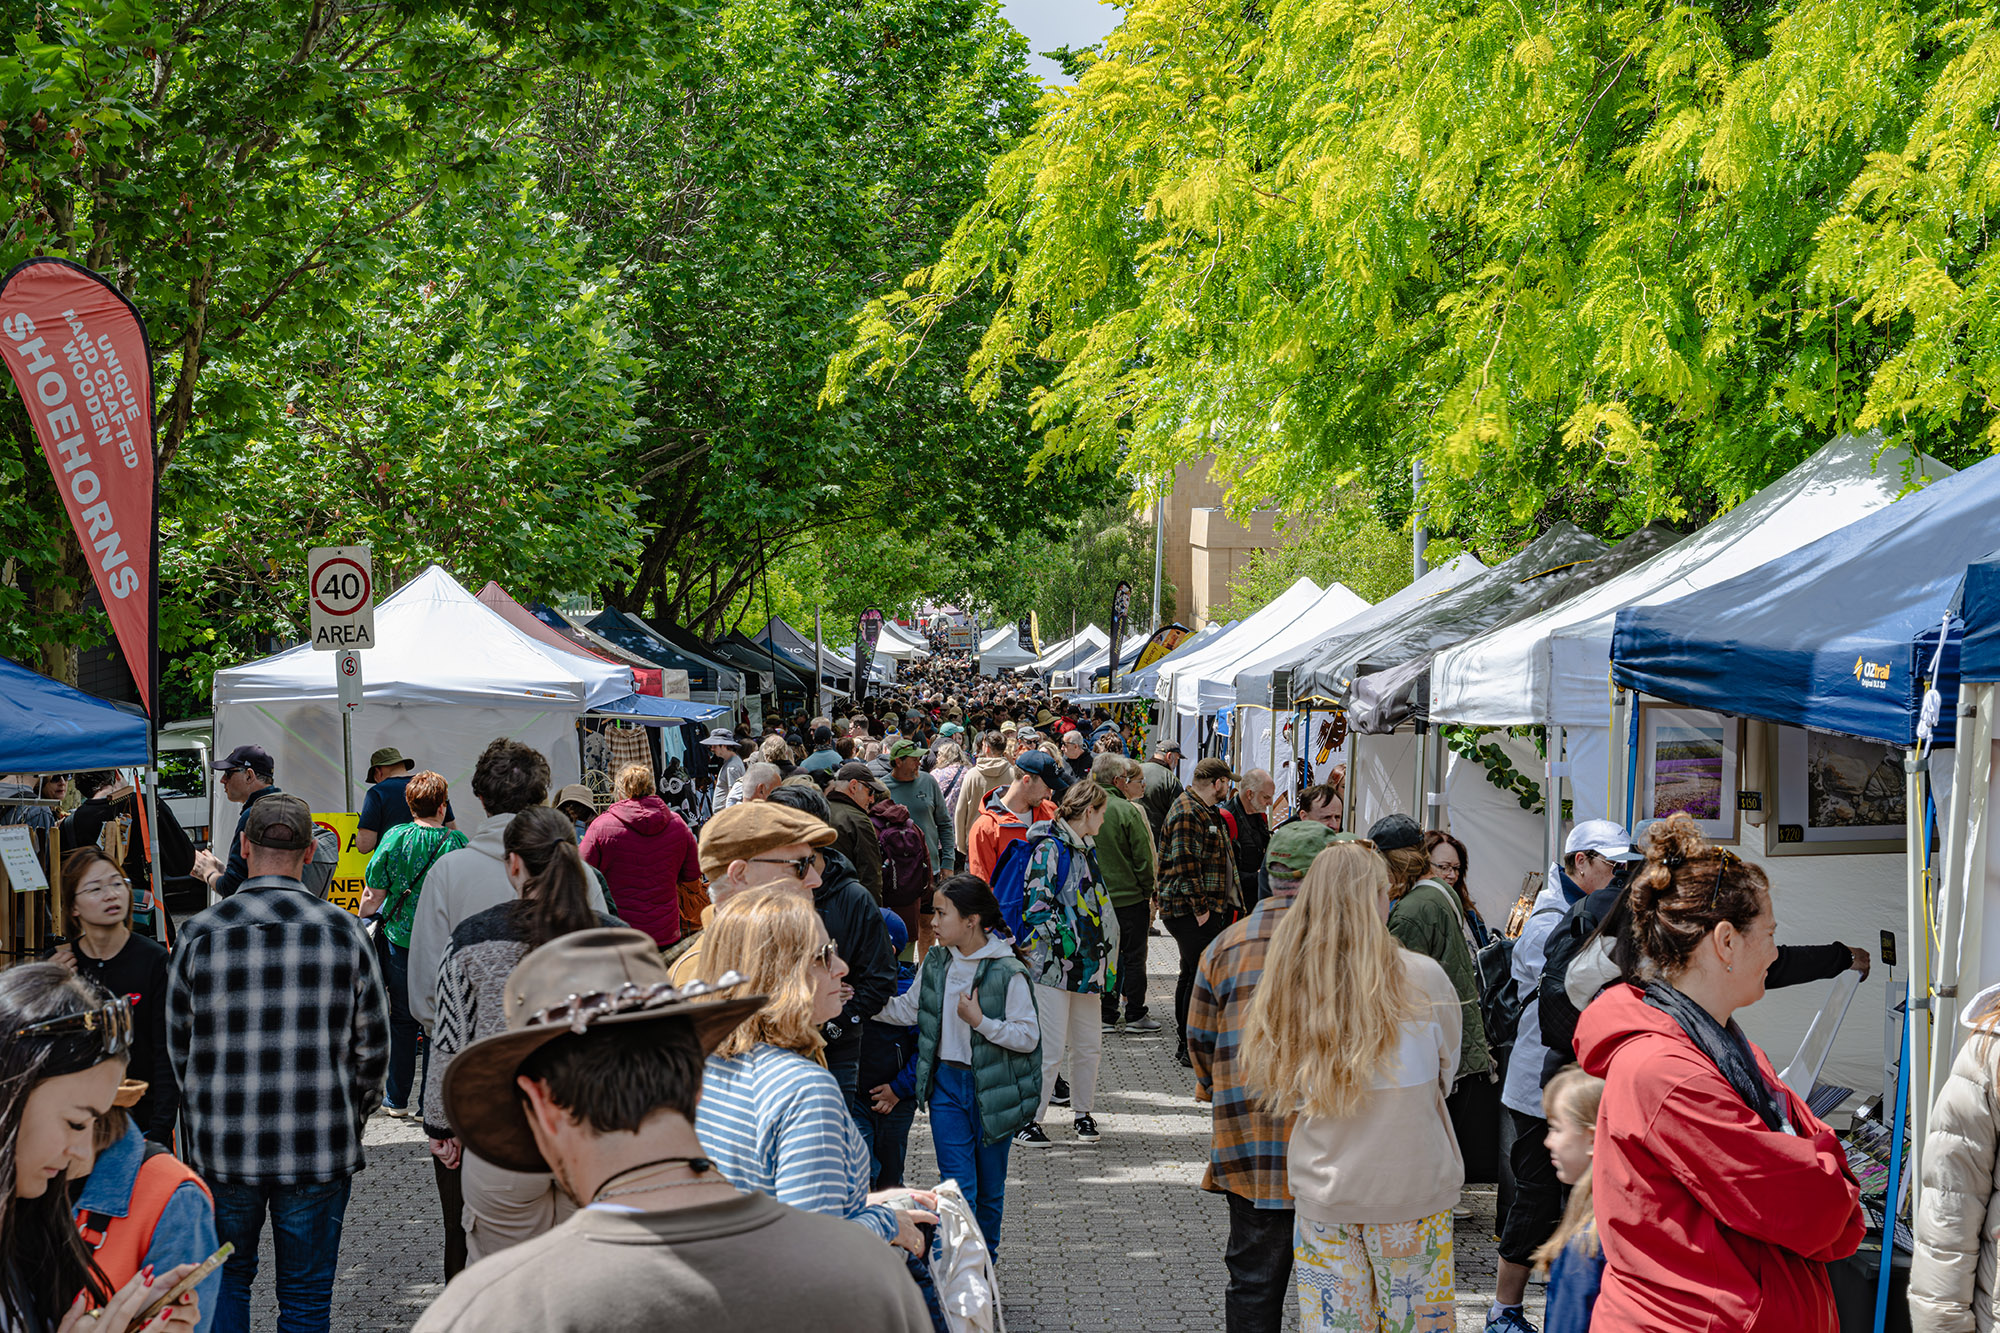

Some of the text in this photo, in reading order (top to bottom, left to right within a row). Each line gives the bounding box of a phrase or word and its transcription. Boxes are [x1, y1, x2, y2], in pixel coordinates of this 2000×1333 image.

[61, 308, 139, 470] HAND CRAFTED
[62, 340, 113, 447] WOODEN
[97, 333, 140, 421] UNIQUE
[2, 311, 140, 600] SHOEHORNS
[321, 573, 360, 600] 40
[316, 624, 370, 646] AREA
[1863, 661, 1891, 680] OZtrail
[330, 879, 367, 893] NE
